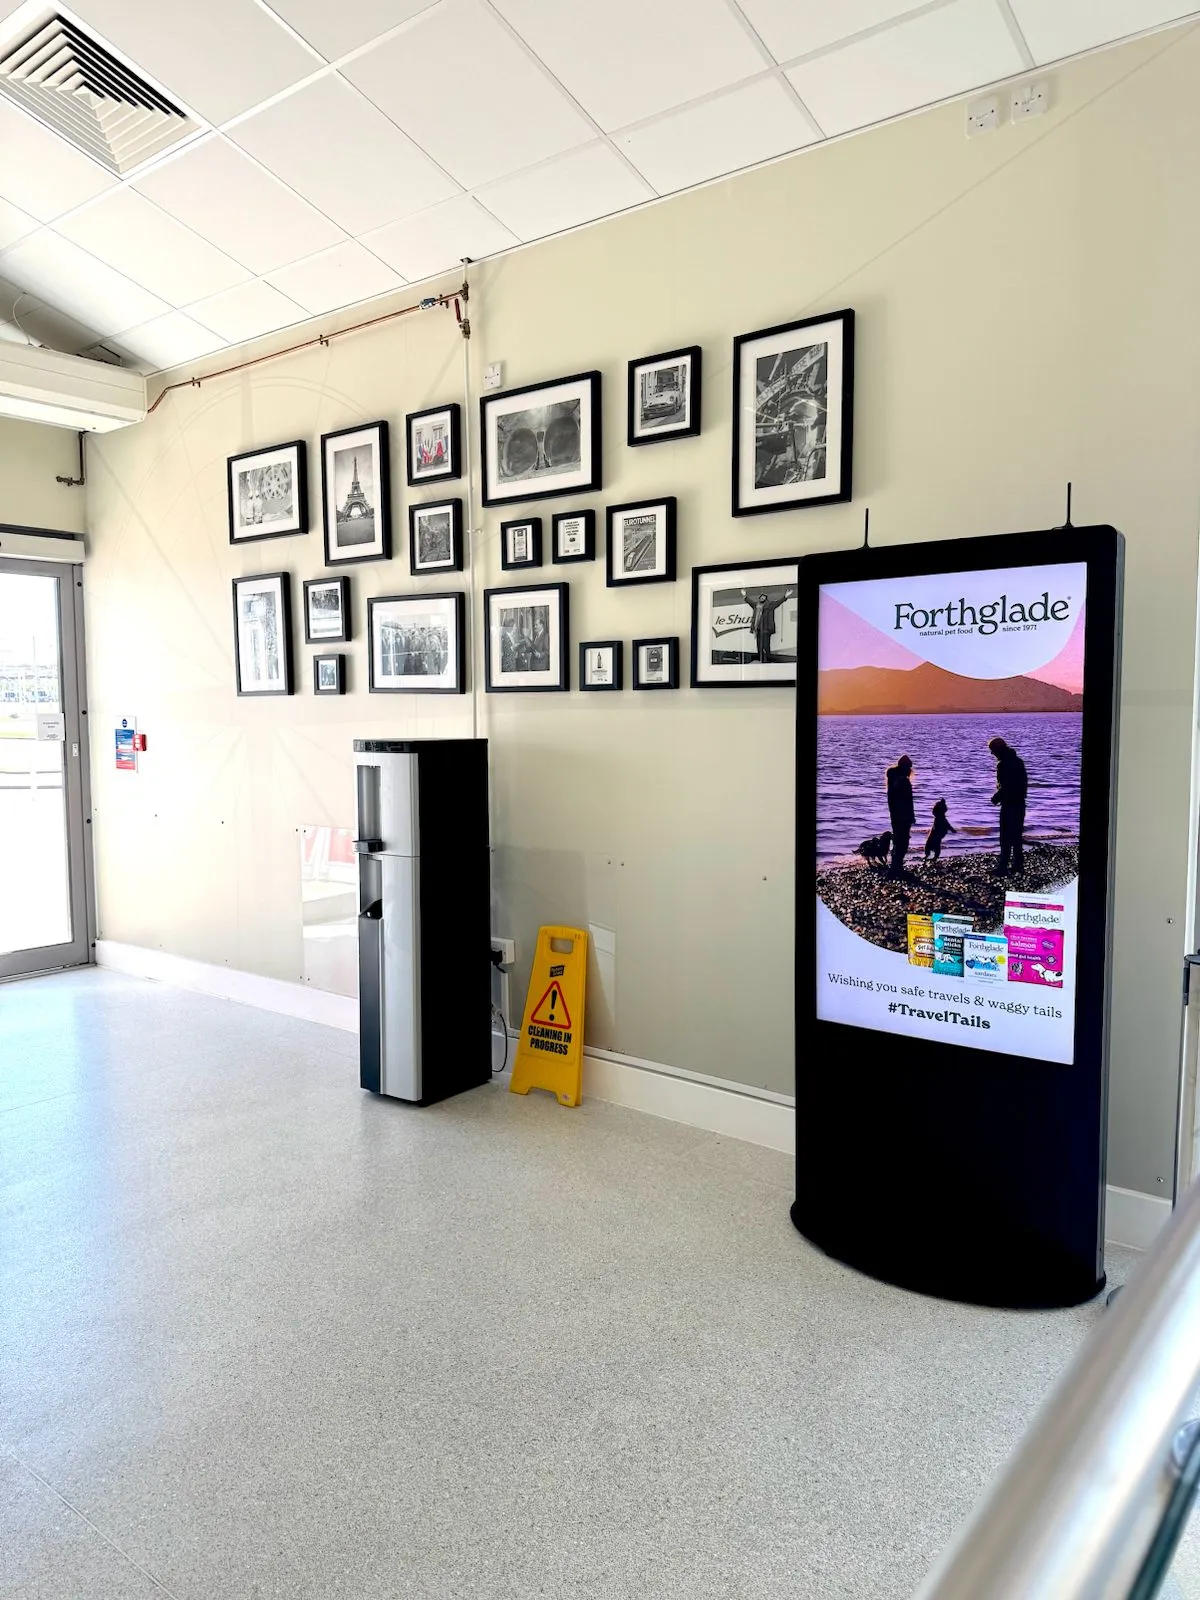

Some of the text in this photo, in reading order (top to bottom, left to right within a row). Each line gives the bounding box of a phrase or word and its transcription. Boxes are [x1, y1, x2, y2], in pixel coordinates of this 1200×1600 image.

[624, 516, 655, 526] EUROTUNNEL
[715, 614, 753, 625] le Shu
[894, 592, 1069, 635] Forthglade
[919, 629, 944, 637] natural
[957, 627, 973, 635] food
[1008, 911, 1060, 925] Forthglade
[935, 924, 971, 935] Forthglade
[969, 942, 1004, 952] Forthglade
[1010, 941, 1037, 949] salmon
[828, 972, 1062, 1019] Wishing you safe travels & waggy tails
[888, 1002, 991, 1029] #TravelTails
[528, 1025, 572, 1043] CLEANING IN
[530, 1038, 568, 1056] PROGRESS
